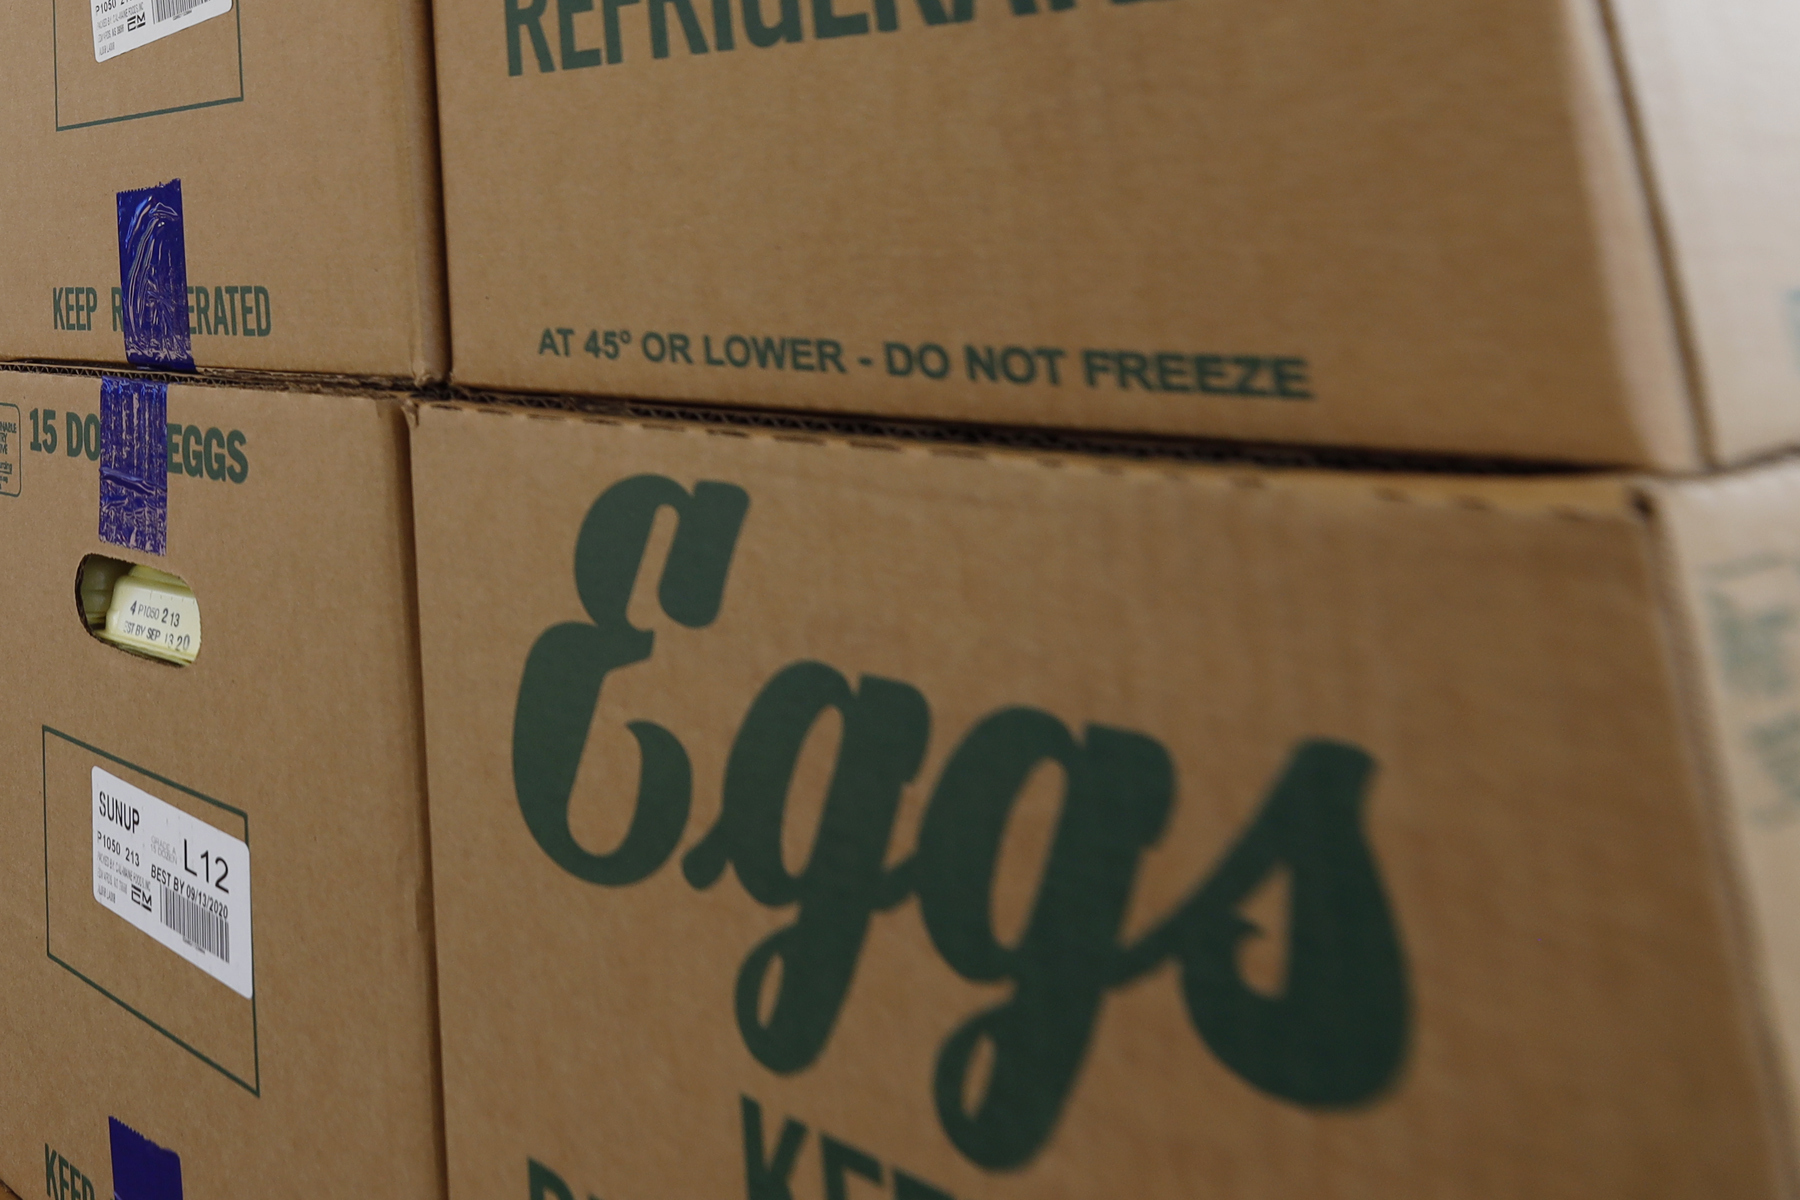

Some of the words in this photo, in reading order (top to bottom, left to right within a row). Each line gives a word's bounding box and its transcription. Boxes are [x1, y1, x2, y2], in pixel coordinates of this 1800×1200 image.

[52, 287, 98, 331] KEEP
[110, 286, 271, 337] RERATED
[537, 327, 575, 356] AT
[641, 333, 693, 364] OR
[703, 336, 845, 372] LOWER
[884, 340, 952, 381] DO
[965, 346, 1066, 389] NOT
[1082, 351, 1315, 400] FREEZE
[29, 408, 57, 454] 15
[166, 423, 249, 484] EGGS
[130, 600, 138, 616] 4
[135, 624, 147, 637] BY
[146, 627, 161, 641] SEP
[175, 634, 191, 652] 20
[99, 791, 140, 834] SUNUP
[511, 472, 1417, 1175] Eggs
[97, 830, 121, 855] P1050
[125, 847, 140, 867] 213
[151, 863, 171, 888] BEST
[173, 875, 185, 892] BY
[186, 884, 229, 920] 09/13/2020
